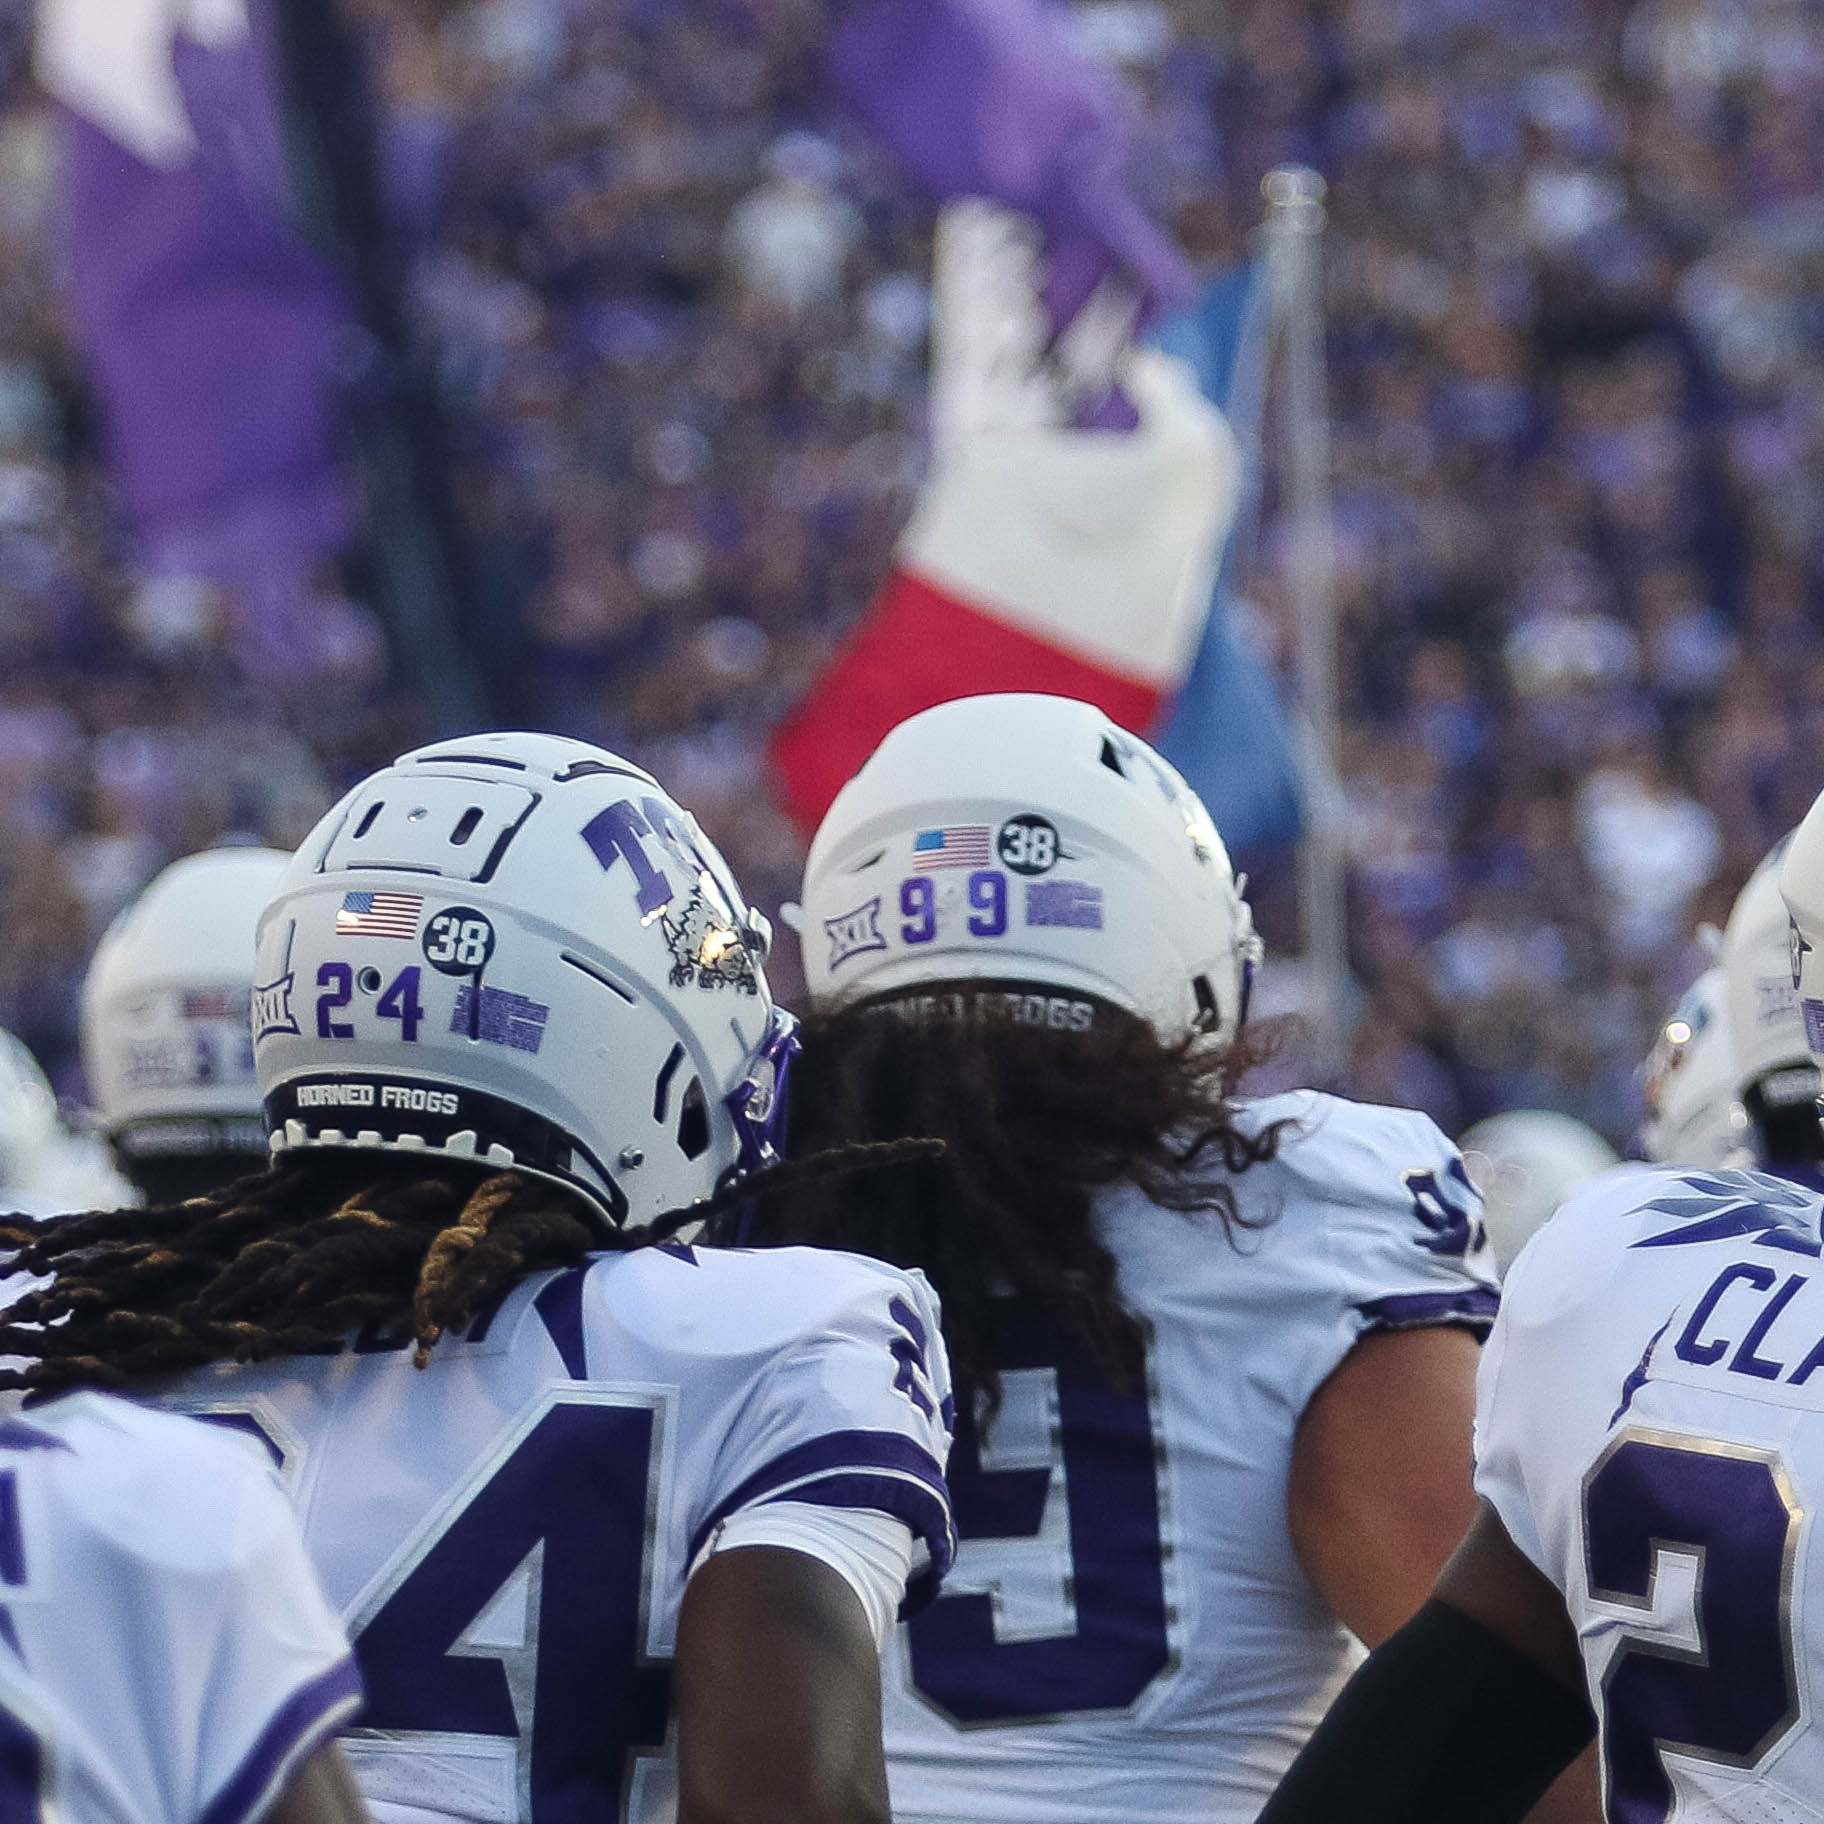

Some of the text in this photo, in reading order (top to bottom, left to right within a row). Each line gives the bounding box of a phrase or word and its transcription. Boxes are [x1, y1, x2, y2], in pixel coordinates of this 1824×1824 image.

[1000, 825, 1054, 869] 38
[427, 913, 488, 967] 38
[316, 962, 424, 1042] 24
[296, 1084, 460, 1116] HORNED FROGS
